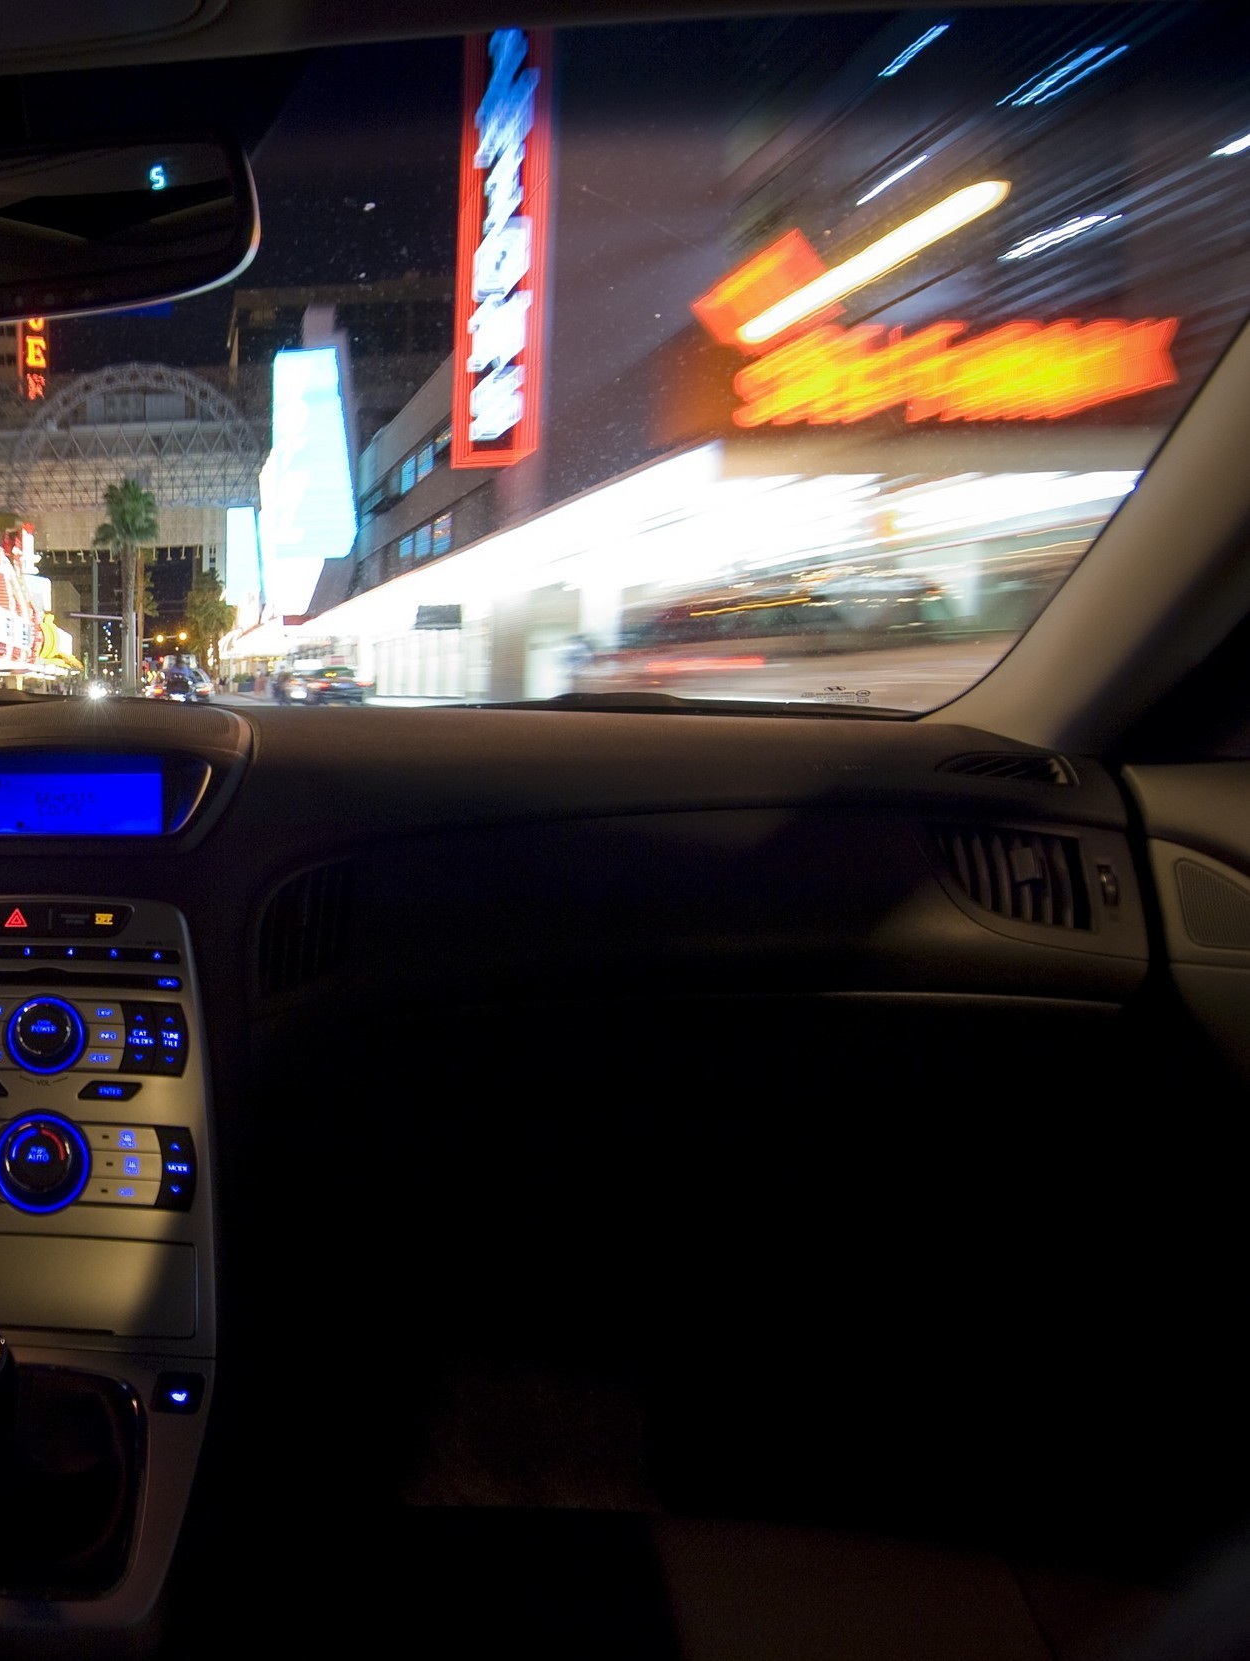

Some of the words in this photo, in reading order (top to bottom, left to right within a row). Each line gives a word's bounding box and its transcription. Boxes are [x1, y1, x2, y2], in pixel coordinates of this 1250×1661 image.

[150, 166, 164, 190] S
[95, 914, 113, 924] OFF
[132, 1029, 148, 1037] CAT
[98, 1086, 122, 1096] ENTER
[166, 1162, 189, 1173] MODE
